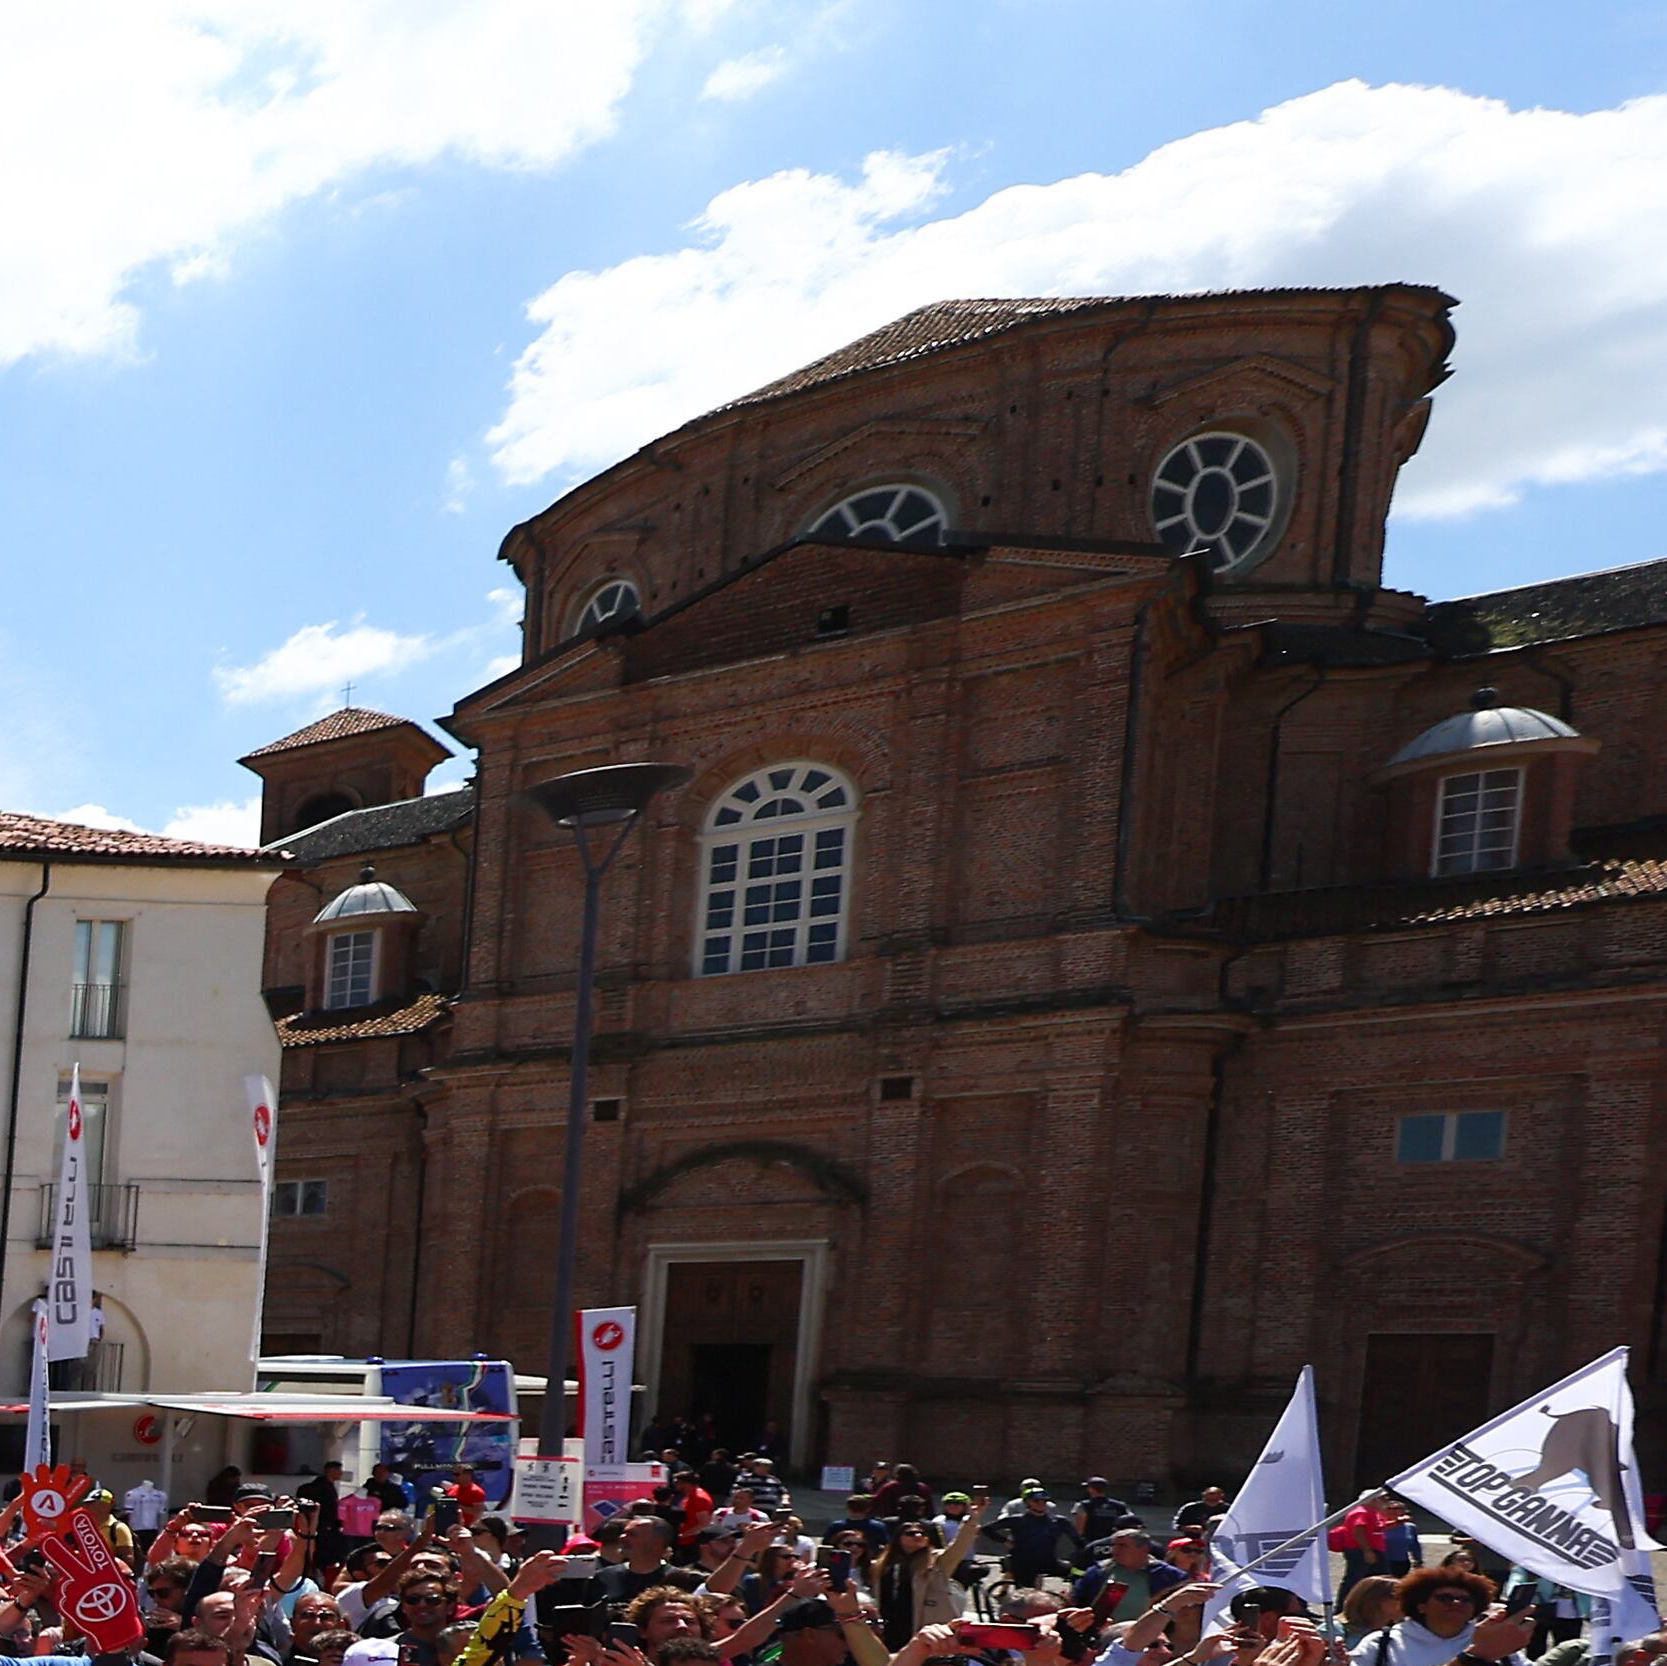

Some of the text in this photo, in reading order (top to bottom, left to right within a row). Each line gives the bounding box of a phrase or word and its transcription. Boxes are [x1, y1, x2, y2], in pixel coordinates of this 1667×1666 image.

[1444, 1445, 1595, 1558] TOP GANNA
[75, 1518, 109, 1570] TOYOTA
